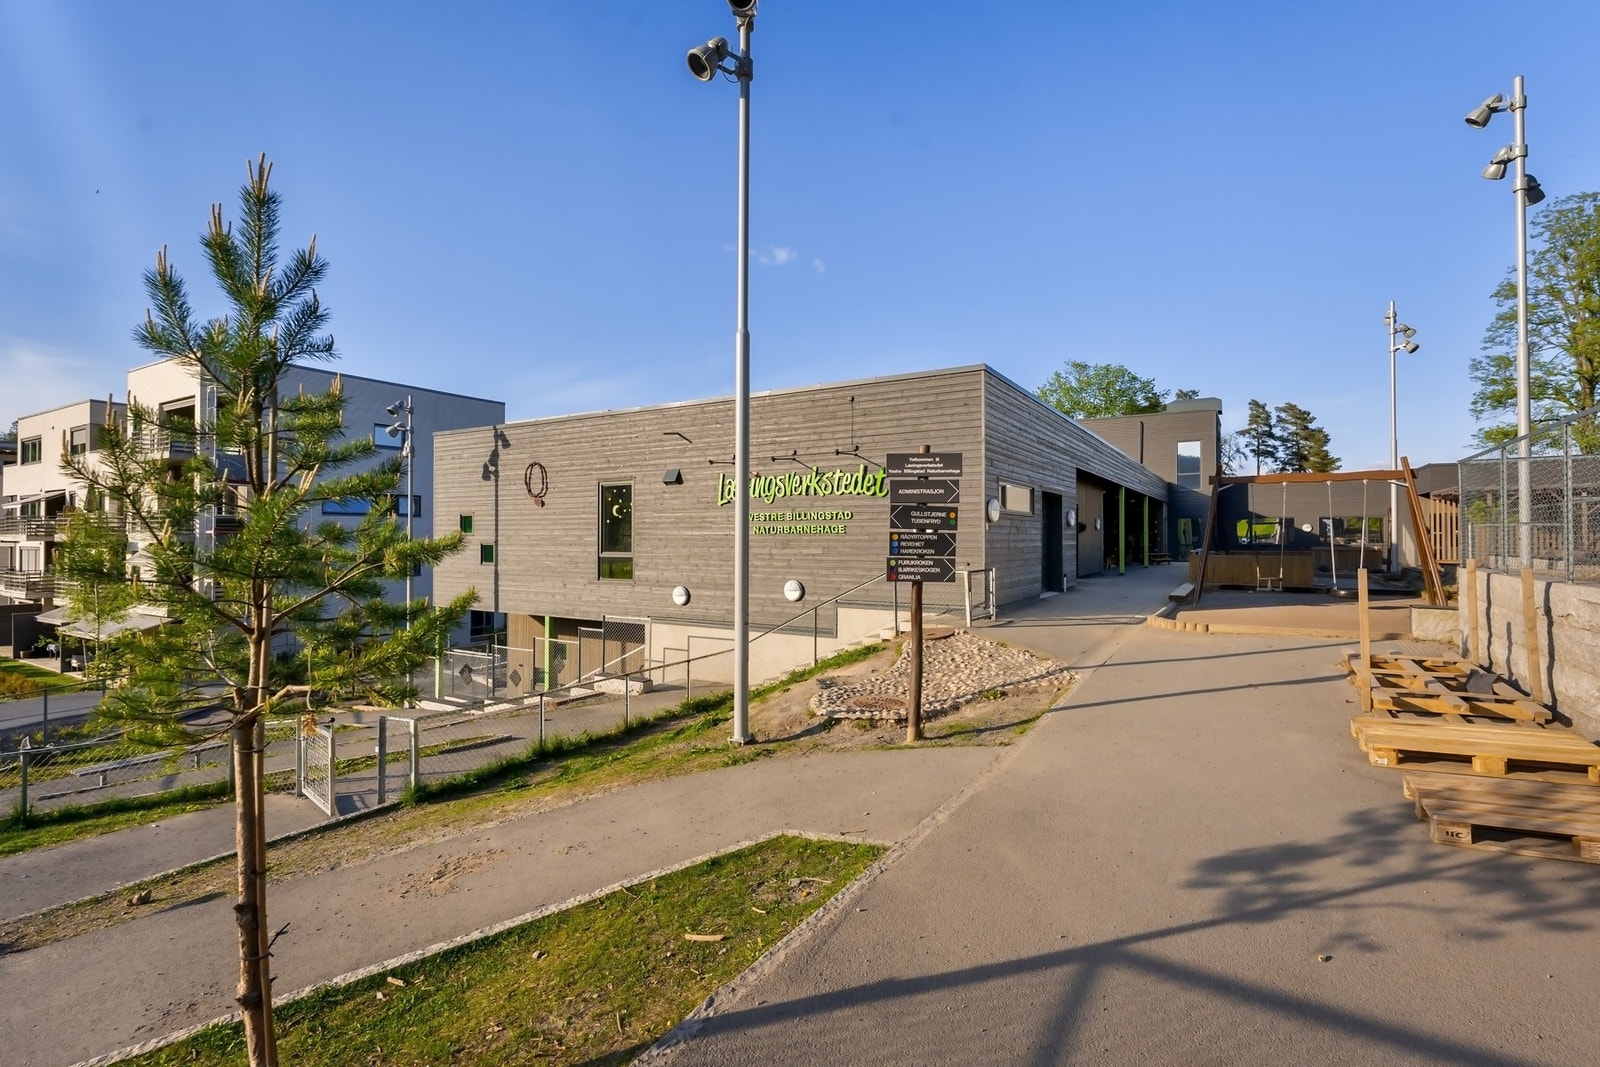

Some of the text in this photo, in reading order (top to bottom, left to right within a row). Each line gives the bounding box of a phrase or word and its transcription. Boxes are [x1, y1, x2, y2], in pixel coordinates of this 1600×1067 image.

[748, 511, 853, 522] VESTRE BILLINGSTAD
[753, 525, 847, 535] NATURBARNEHAGE
